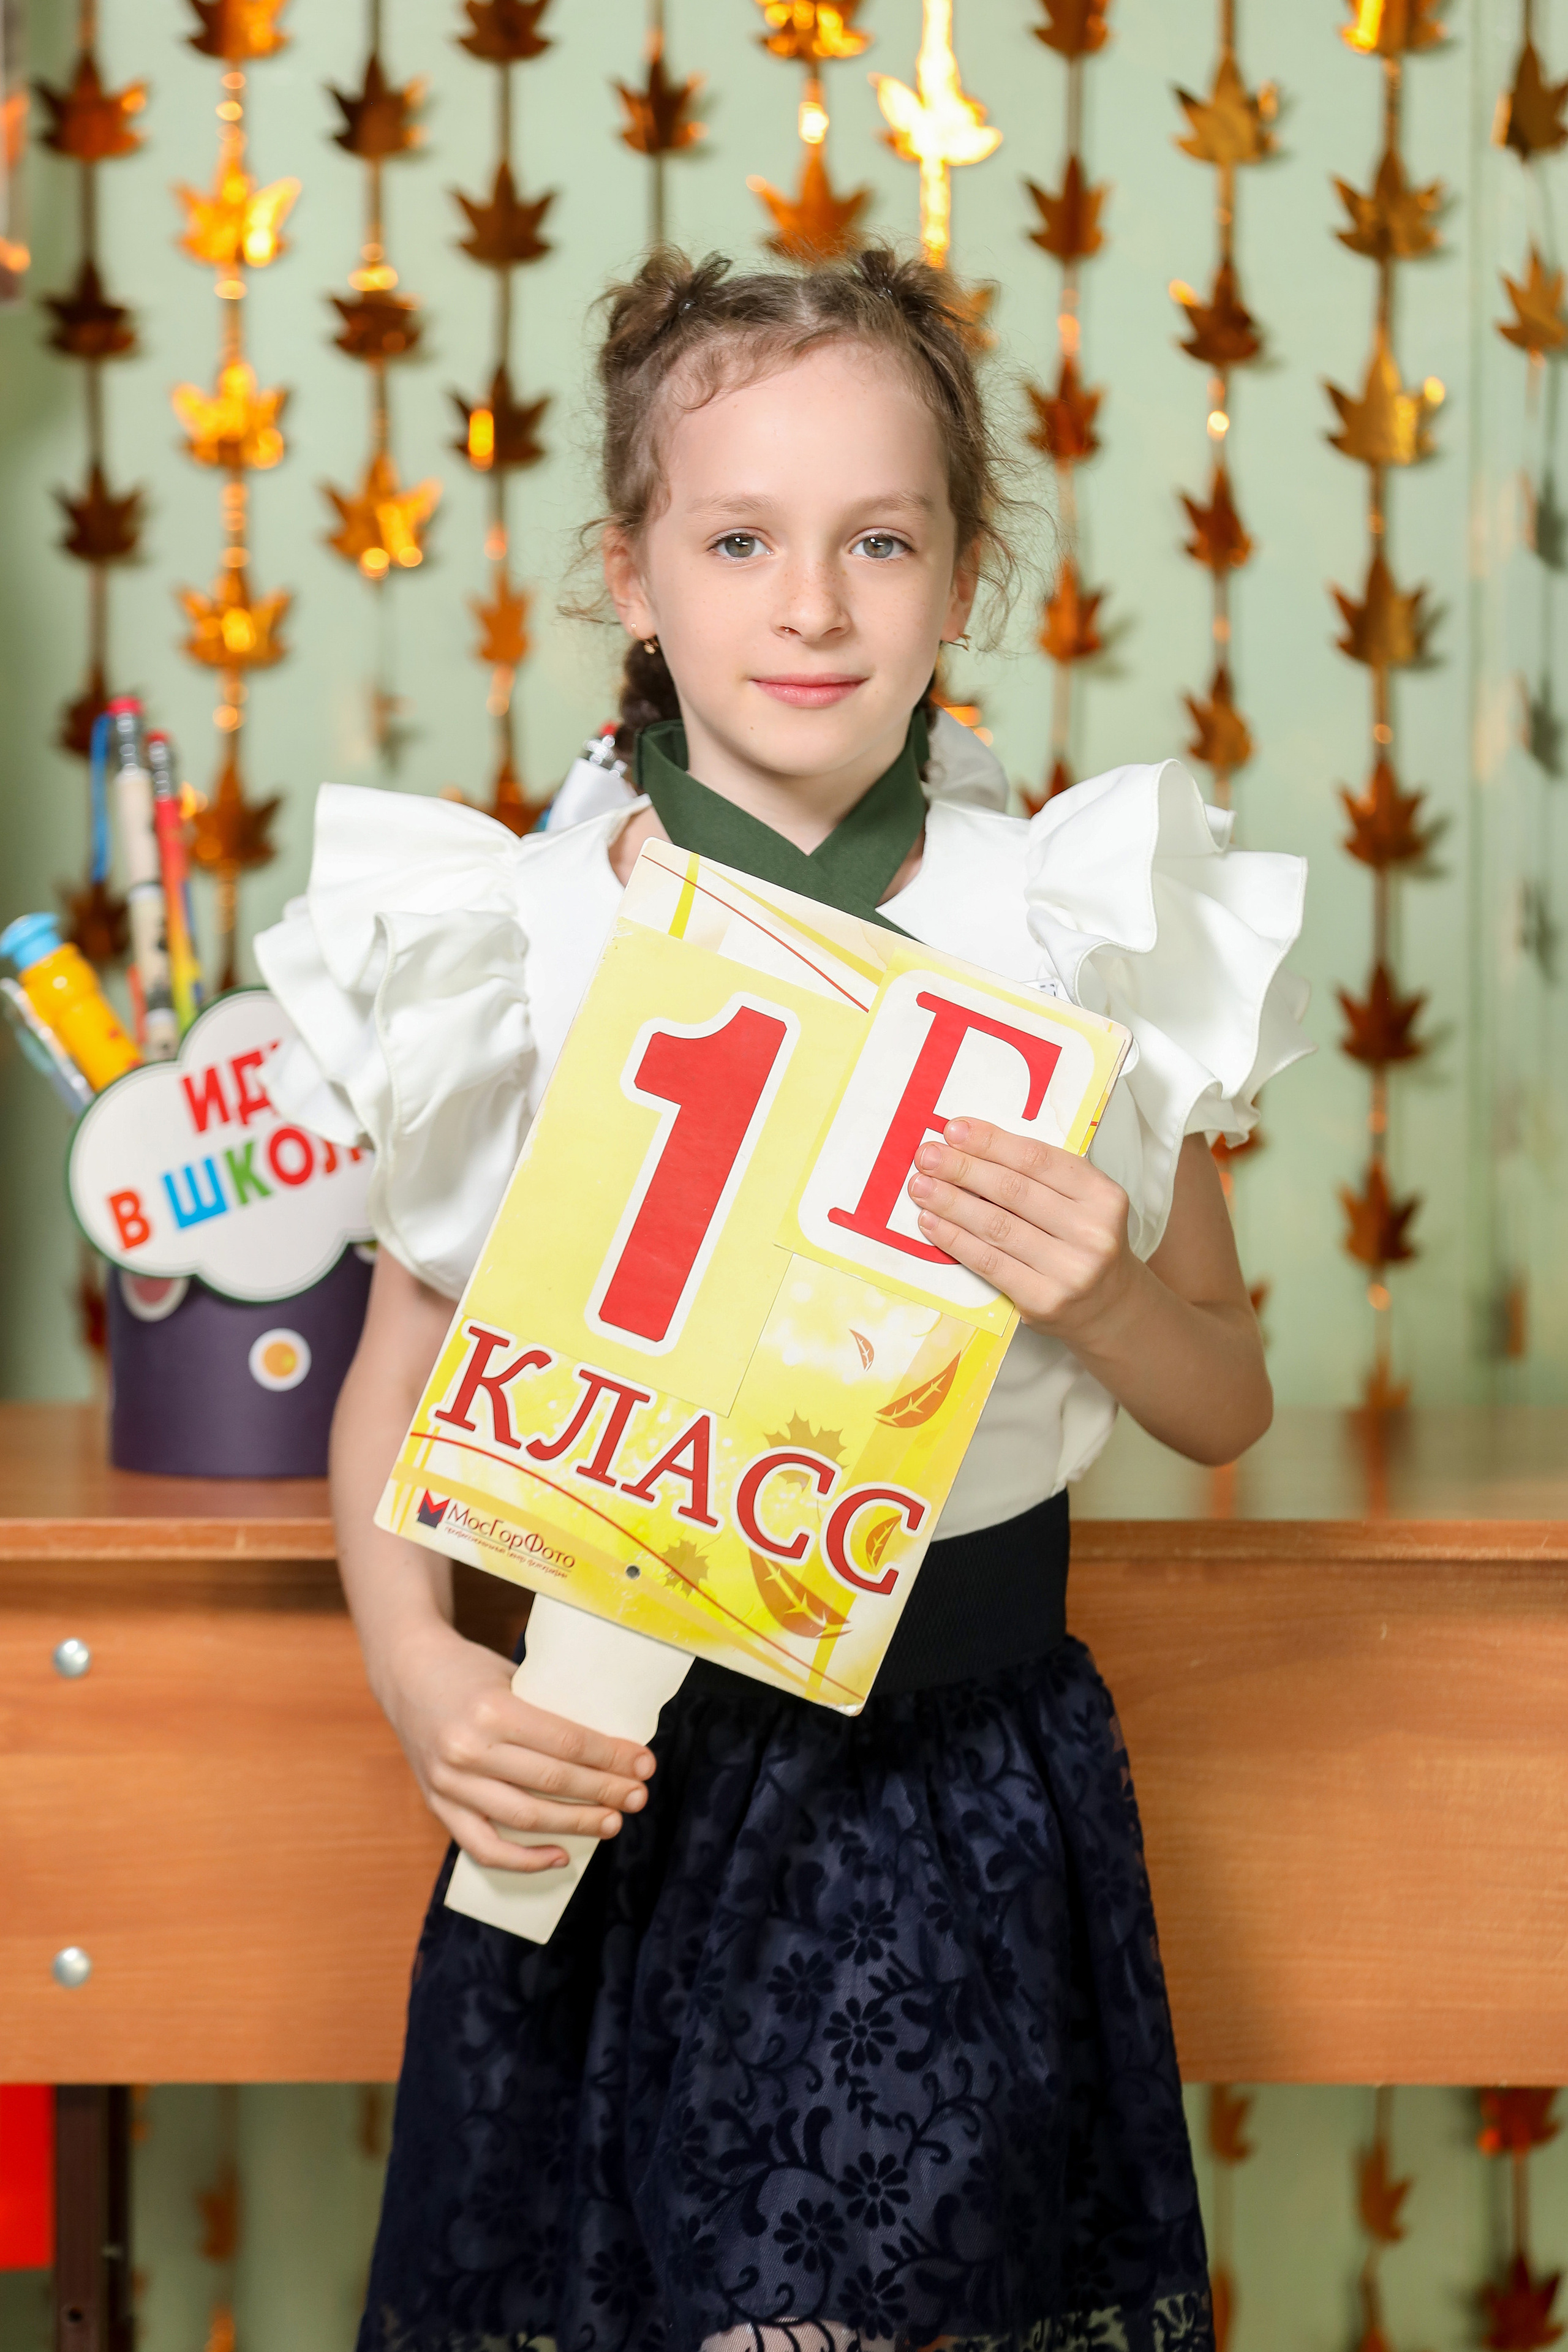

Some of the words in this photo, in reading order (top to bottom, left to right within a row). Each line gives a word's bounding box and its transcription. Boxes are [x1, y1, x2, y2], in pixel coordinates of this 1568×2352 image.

[183, 1039, 282, 1133] ИД
[109, 1190, 151, 1250] В
[434, 1325, 925, 1595] КЛАСС
[448, 1504, 575, 1568] МосГорФото
